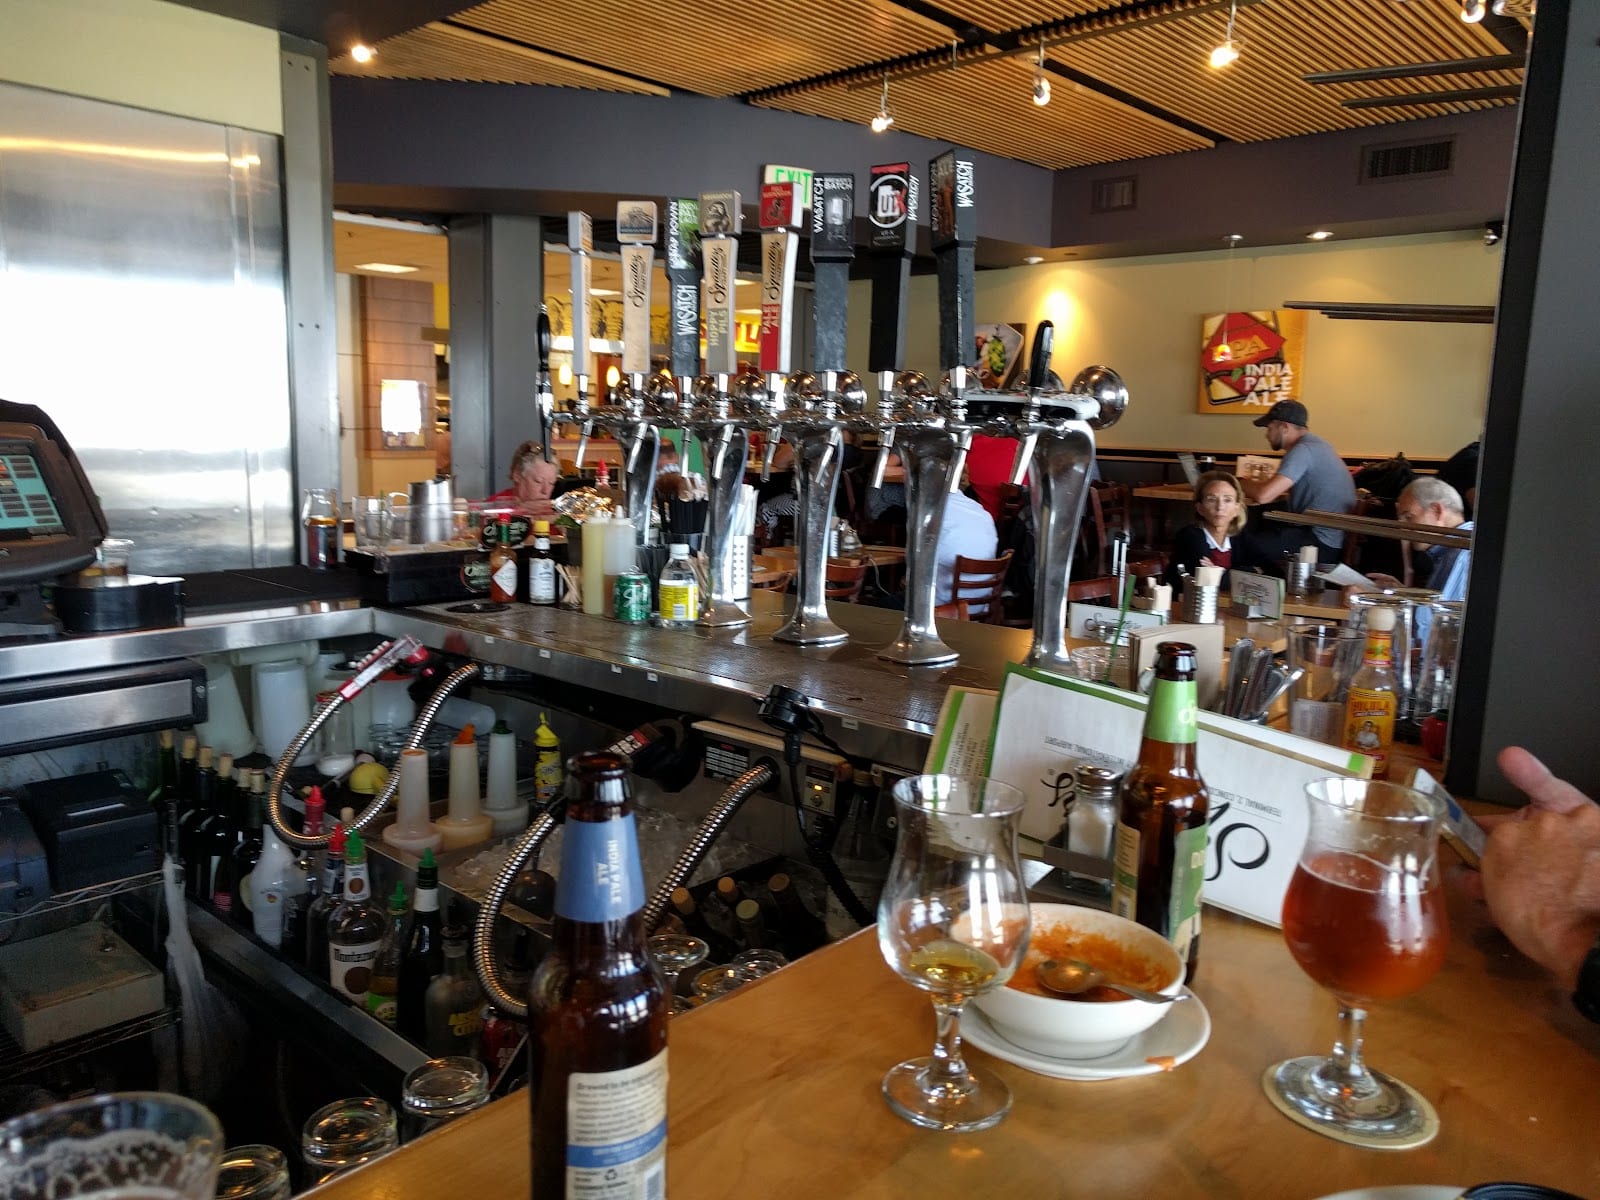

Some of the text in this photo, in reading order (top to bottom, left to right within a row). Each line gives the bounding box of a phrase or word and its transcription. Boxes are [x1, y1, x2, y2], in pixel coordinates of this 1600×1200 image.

[908, 174, 920, 221] WASATCH
[956, 160, 974, 208] WASATCH
[669, 201, 680, 235] DOWN
[813, 177, 825, 234] WASATCH
[627, 254, 645, 308] Squatters
[707, 247, 727, 304] Squatters
[765, 241, 781, 300] Squatters
[676, 284, 698, 336] WASATCH
[709, 309, 720, 346] HOPPY
[719, 309, 728, 335] PILS
[762, 305, 771, 334] PALE
[770, 305, 780, 327] ALE
[1243, 375, 1293, 392] PALE
[1244, 363, 1294, 377] INDIA
[1242, 390, 1291, 407] ALE
[596, 863, 609, 885] ALE
[608, 840, 622, 904] INDIA PALE
